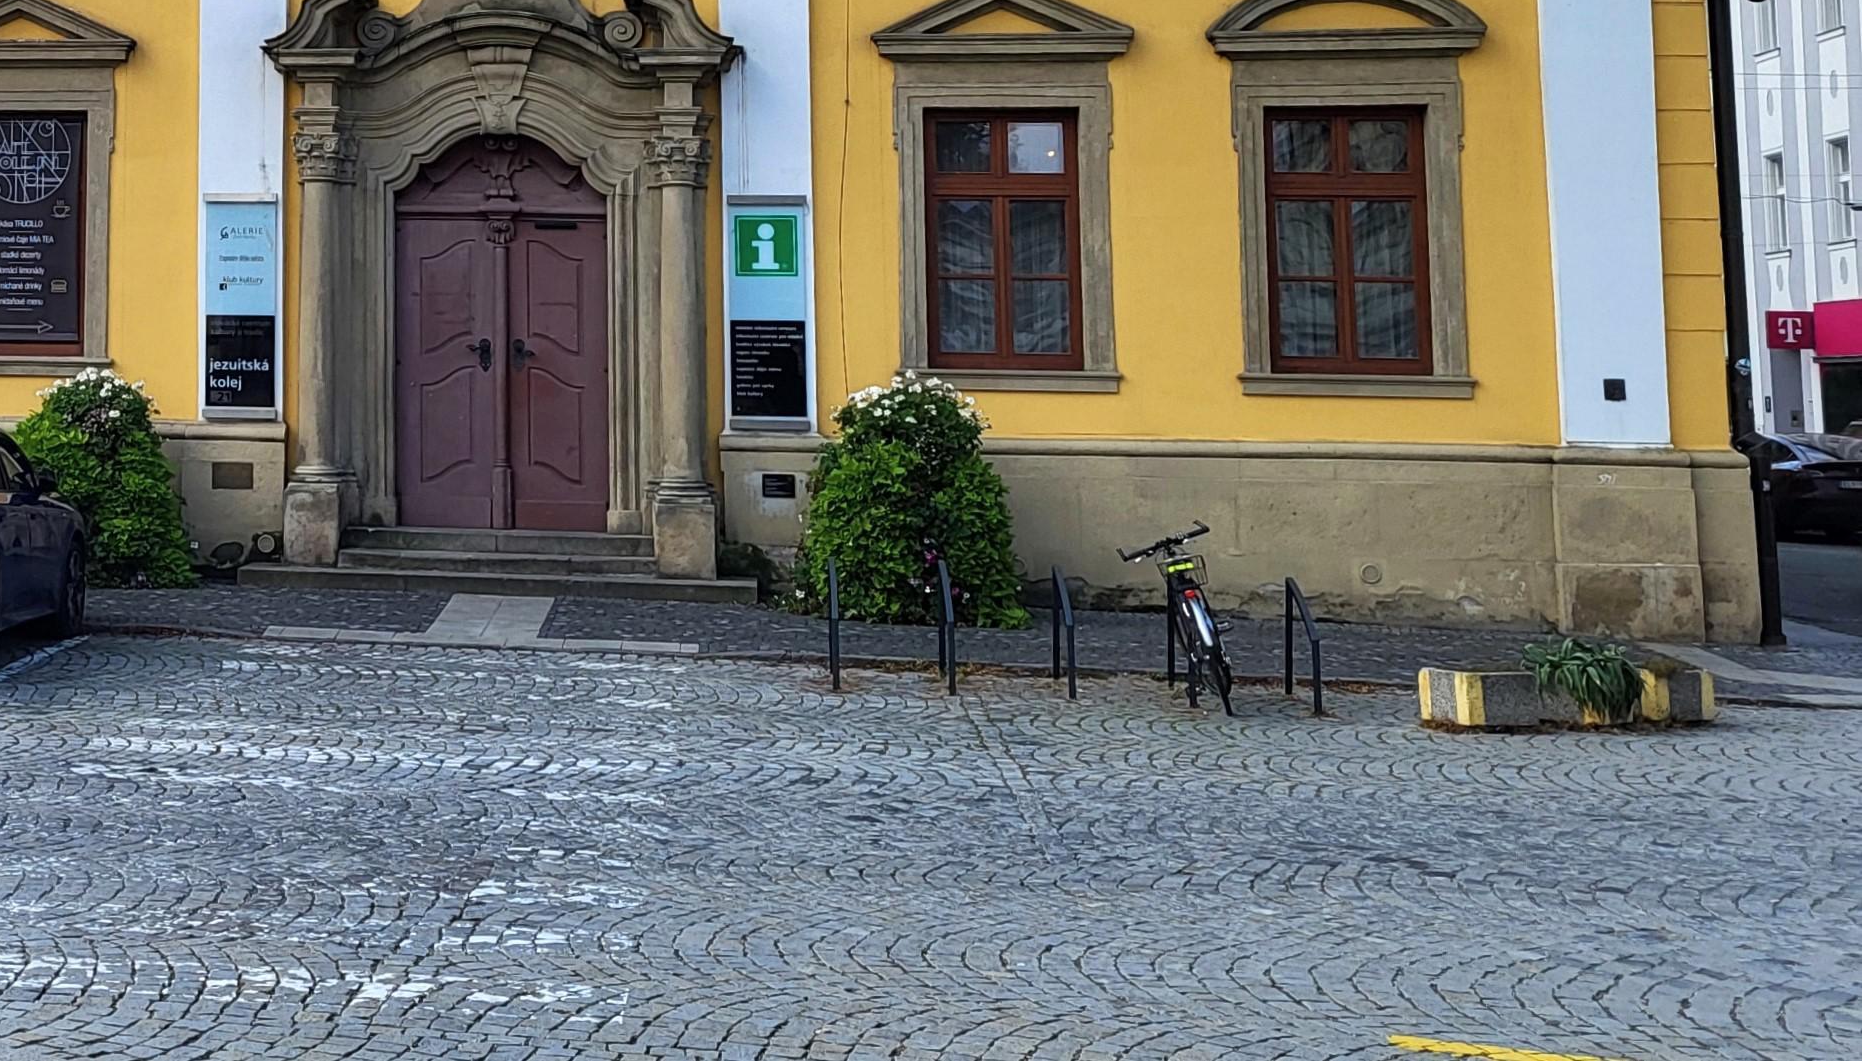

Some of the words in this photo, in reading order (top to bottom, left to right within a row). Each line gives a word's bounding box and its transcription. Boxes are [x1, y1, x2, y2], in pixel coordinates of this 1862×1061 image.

[42, 235, 55, 243] TEA
[1778, 317, 1803, 343] T
[209, 357, 270, 373] jezuitská
[209, 375, 242, 391] kolej
